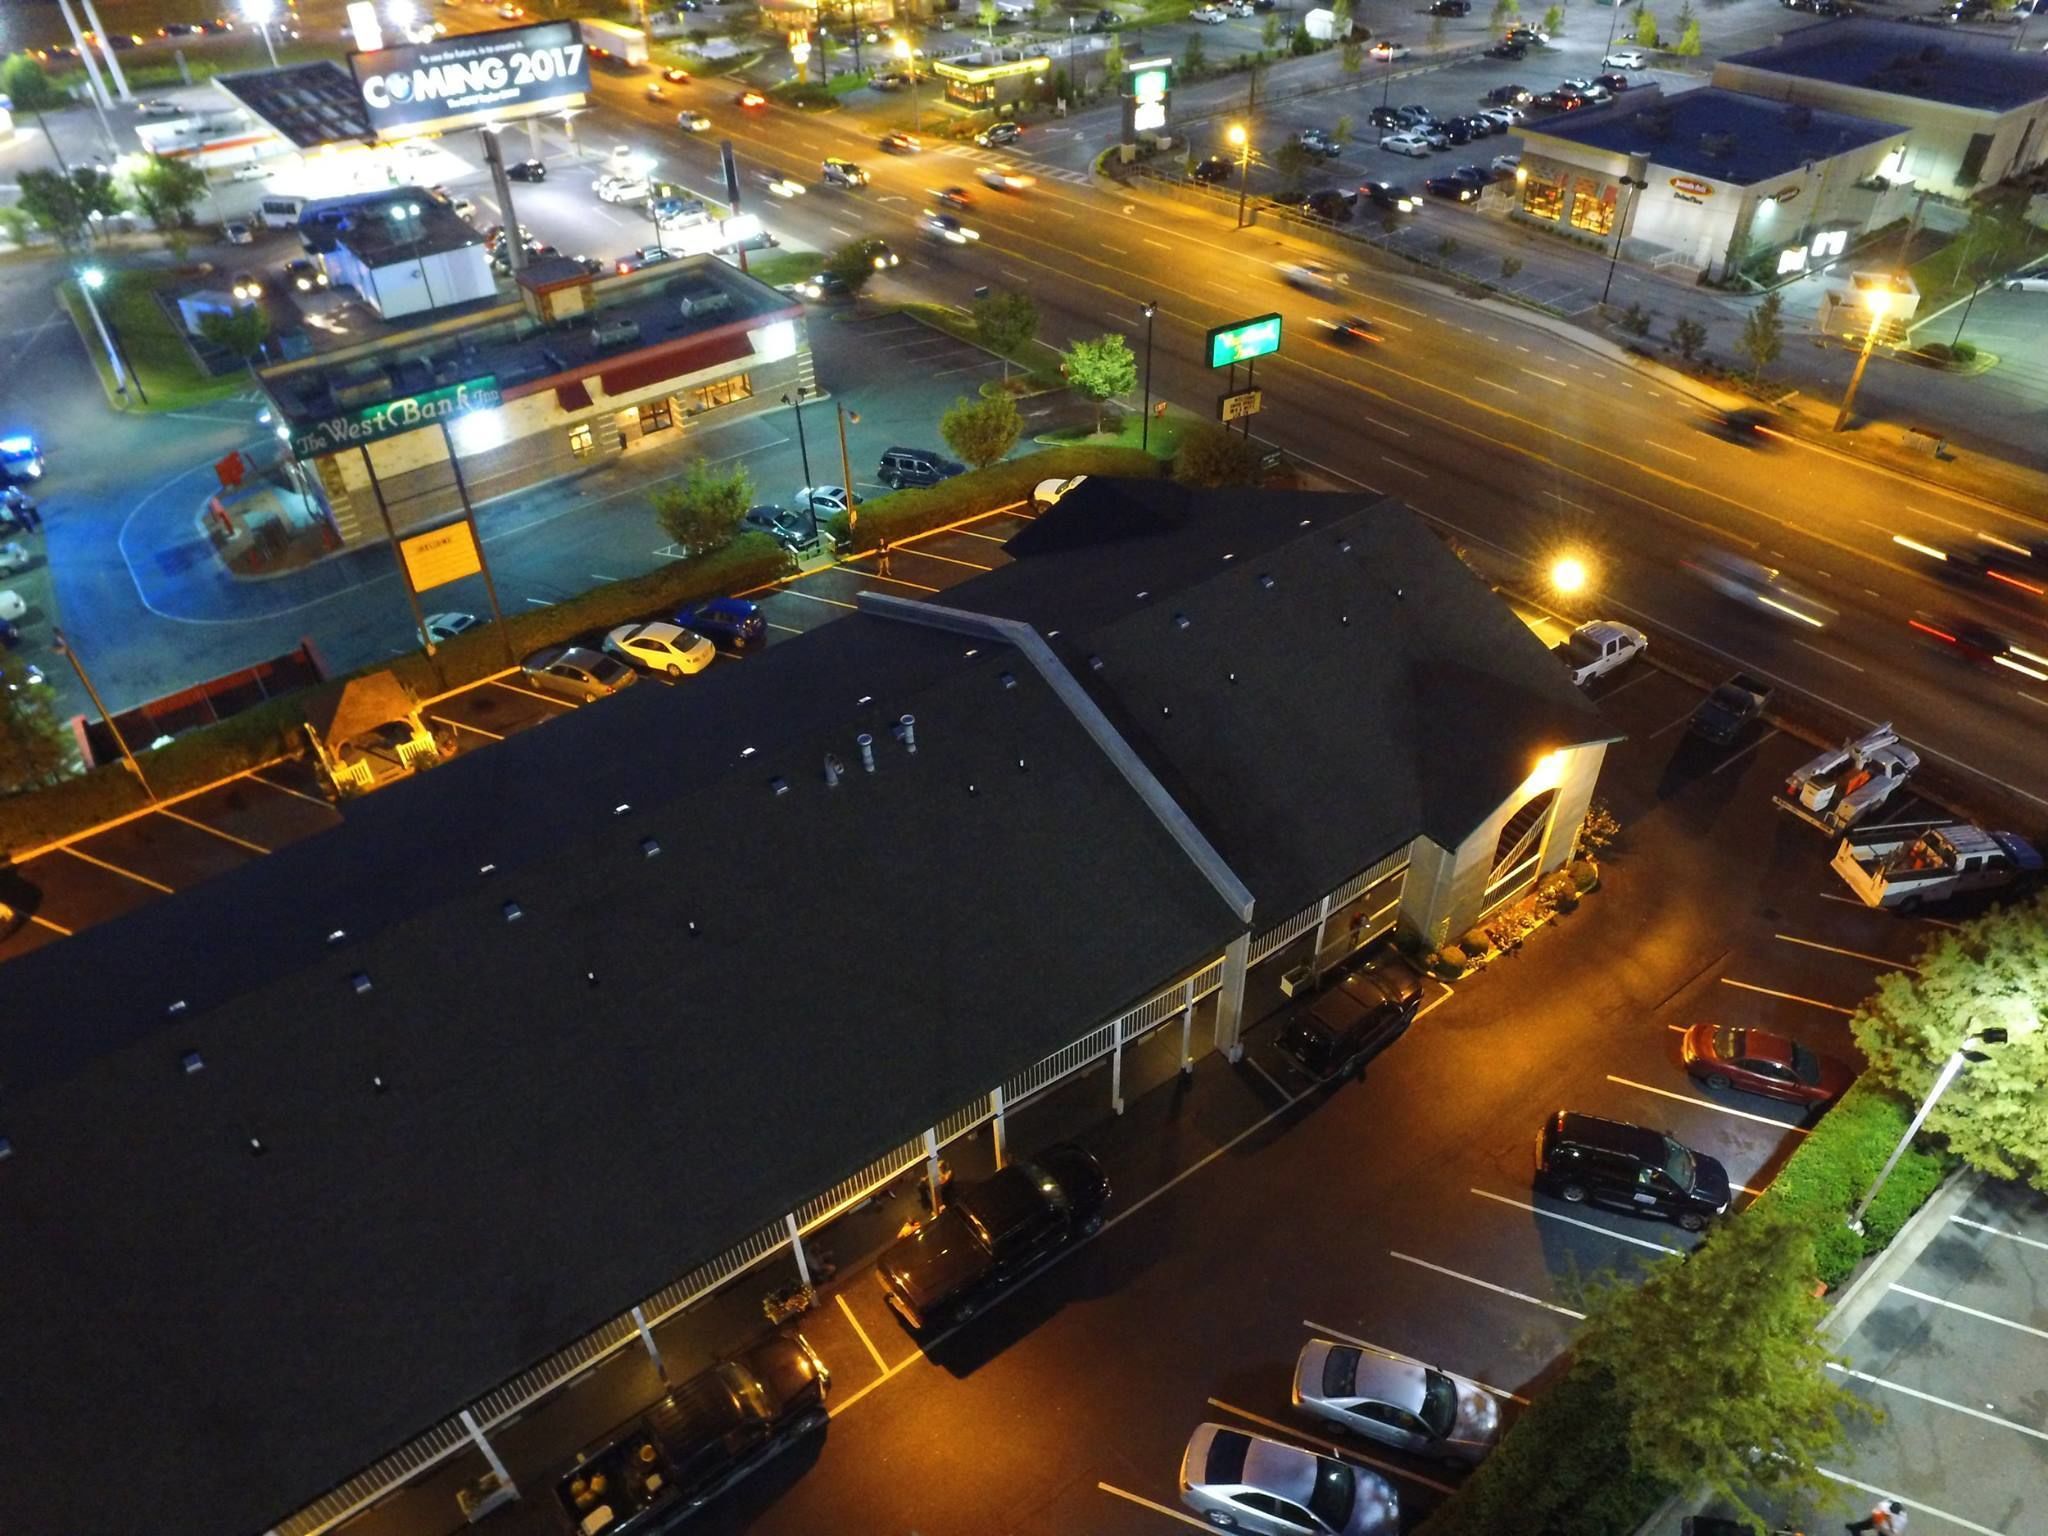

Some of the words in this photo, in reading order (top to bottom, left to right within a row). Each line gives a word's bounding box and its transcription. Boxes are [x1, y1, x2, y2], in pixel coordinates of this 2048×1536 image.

[362, 57, 508, 108] COMING
[509, 43, 584, 85] 2017
[297, 432, 327, 454] The
[318, 411, 387, 442] West
[387, 385, 470, 427] Bank
[473, 388, 500, 402] Inn
